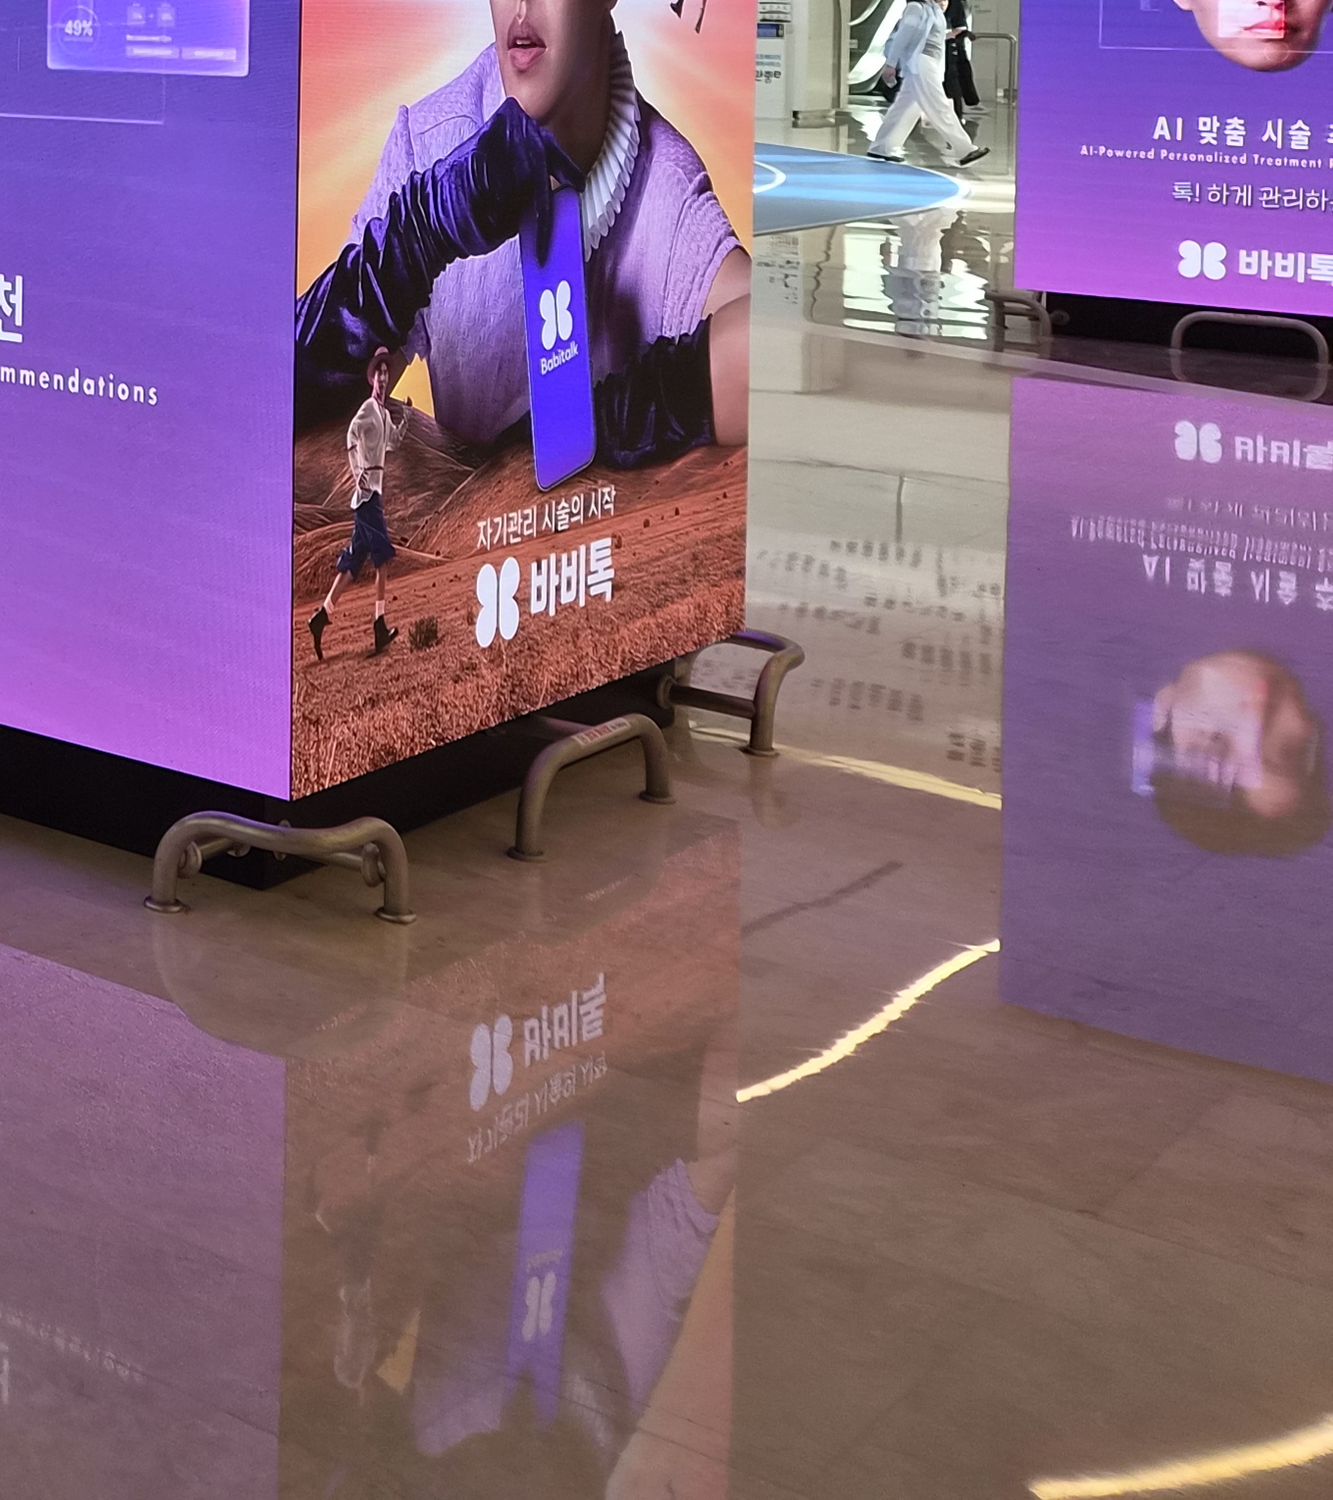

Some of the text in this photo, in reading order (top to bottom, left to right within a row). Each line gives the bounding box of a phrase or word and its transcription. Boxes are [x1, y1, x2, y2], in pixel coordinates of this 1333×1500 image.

[64, 19, 94, 37] 49%
[1152, 116, 1183, 141] AI
[1197, 115, 1247, 147] 맞춤
[1261, 117, 1312, 151] 시술
[1080, 145, 1155, 160] AI-Powered
[1160, 149, 1247, 165] Personalized
[1252, 153, 1323, 169] Treatment
[1172, 181, 1201, 203] 톡!
[1207, 183, 1252, 208] 하게
[1238, 249, 1333, 287] 바비톡
[539, 341, 579, 376] Babitalk
[476, 484, 617, 550] 자기관리 시술의 시작
[530, 536, 615, 617] 바비톡
